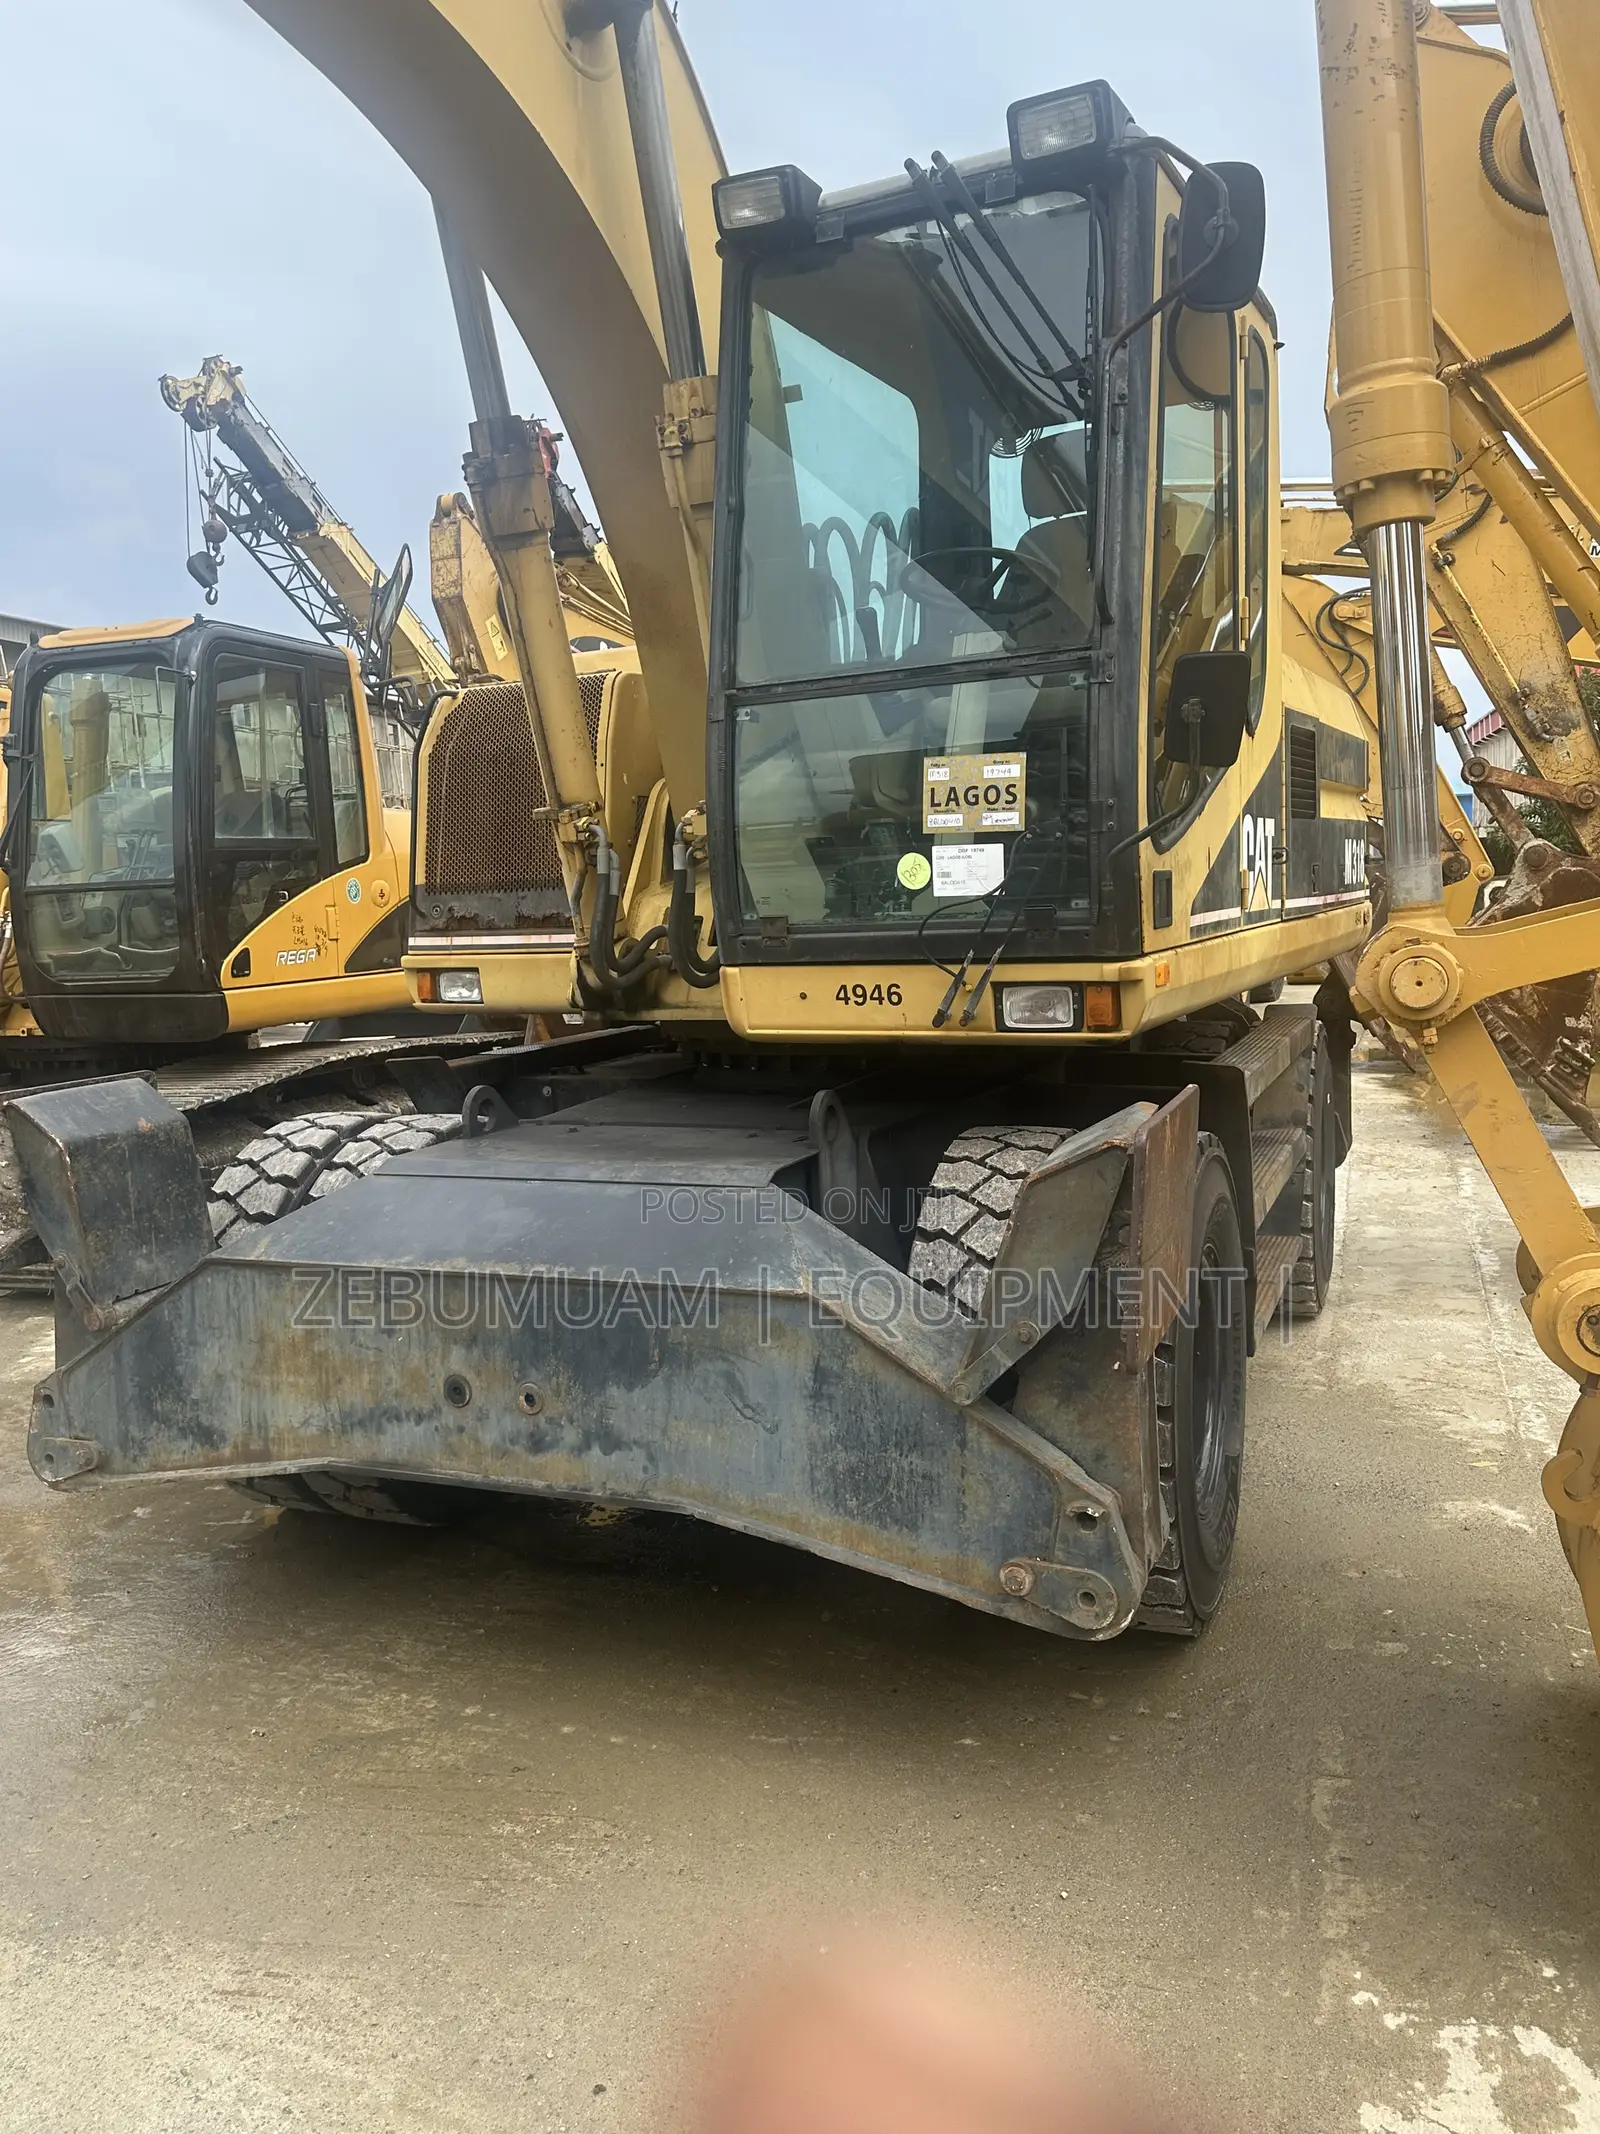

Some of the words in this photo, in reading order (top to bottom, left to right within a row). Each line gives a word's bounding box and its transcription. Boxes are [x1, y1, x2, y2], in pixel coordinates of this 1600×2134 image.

[930, 784, 1018, 808] LAGOS
[1242, 813, 1276, 913] CAT
[1344, 838, 1365, 885] M318
[275, 948, 317, 967] REGA
[835, 983, 903, 1006] 4946
